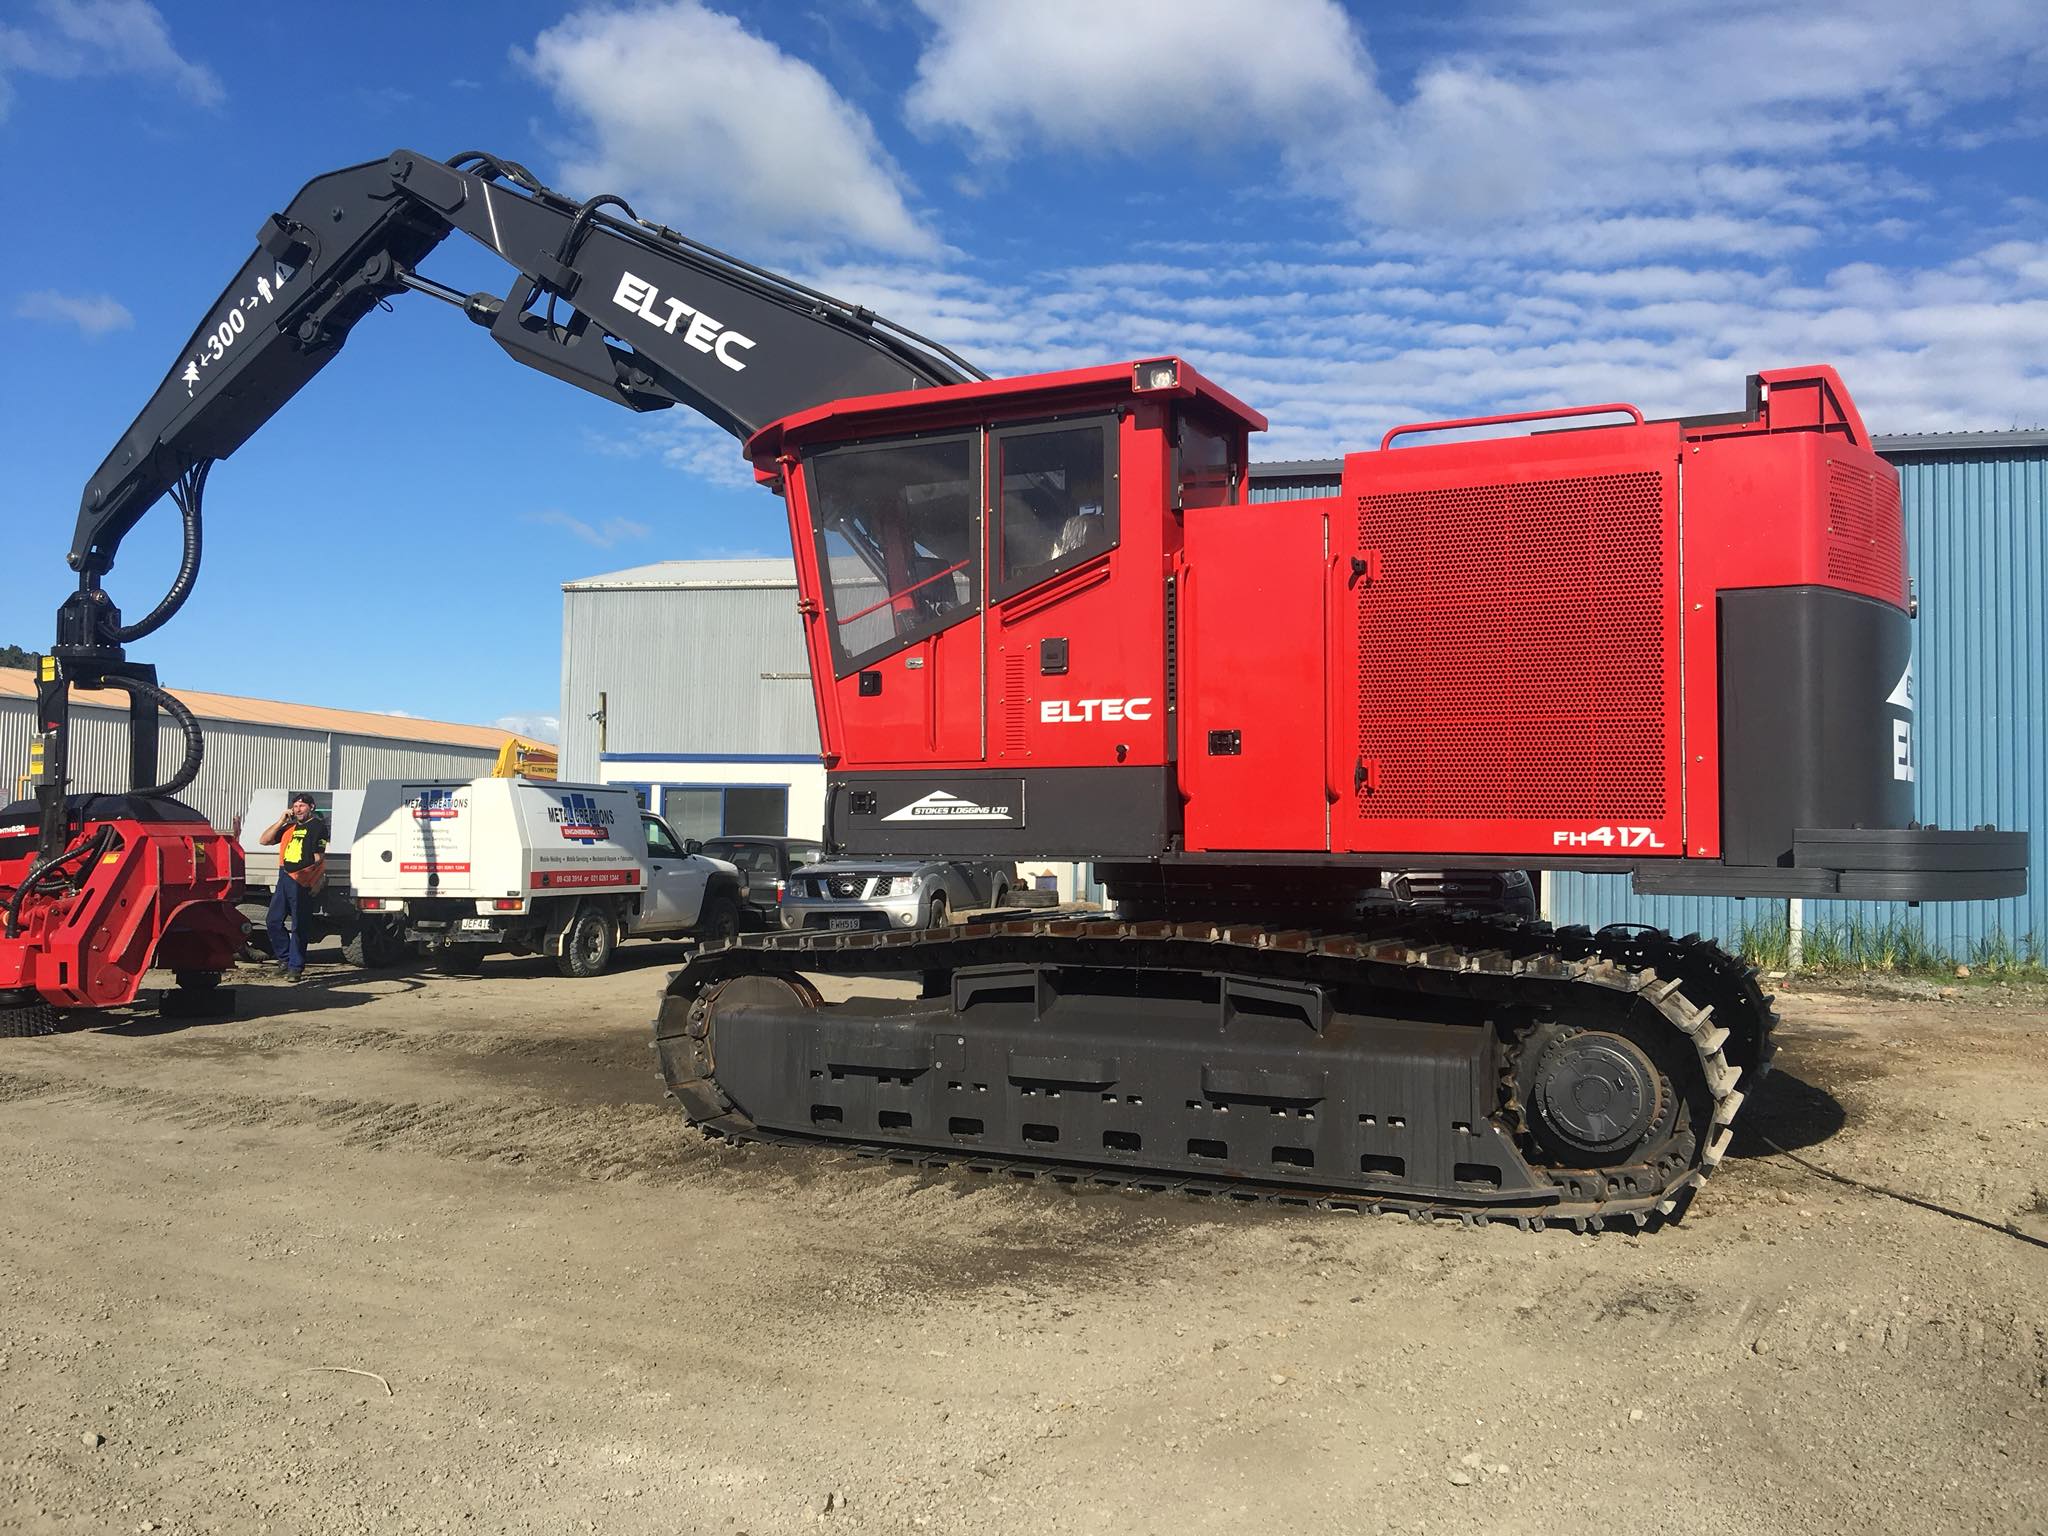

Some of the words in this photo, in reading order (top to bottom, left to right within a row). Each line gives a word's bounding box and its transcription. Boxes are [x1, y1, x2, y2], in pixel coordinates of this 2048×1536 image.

[612, 271, 757, 372] ELTEC
[1040, 698, 1152, 723] ELTEC
[405, 799, 428, 808] METAL
[430, 799, 469, 808] CREATIONS
[914, 807, 948, 815] STOKES
[950, 806, 989, 814] LOGGING
[991, 806, 1008, 814] LTD
[548, 807, 574, 823] METAL
[575, 809, 615, 824] CREATIONS
[1553, 826, 1665, 848] FH417L
